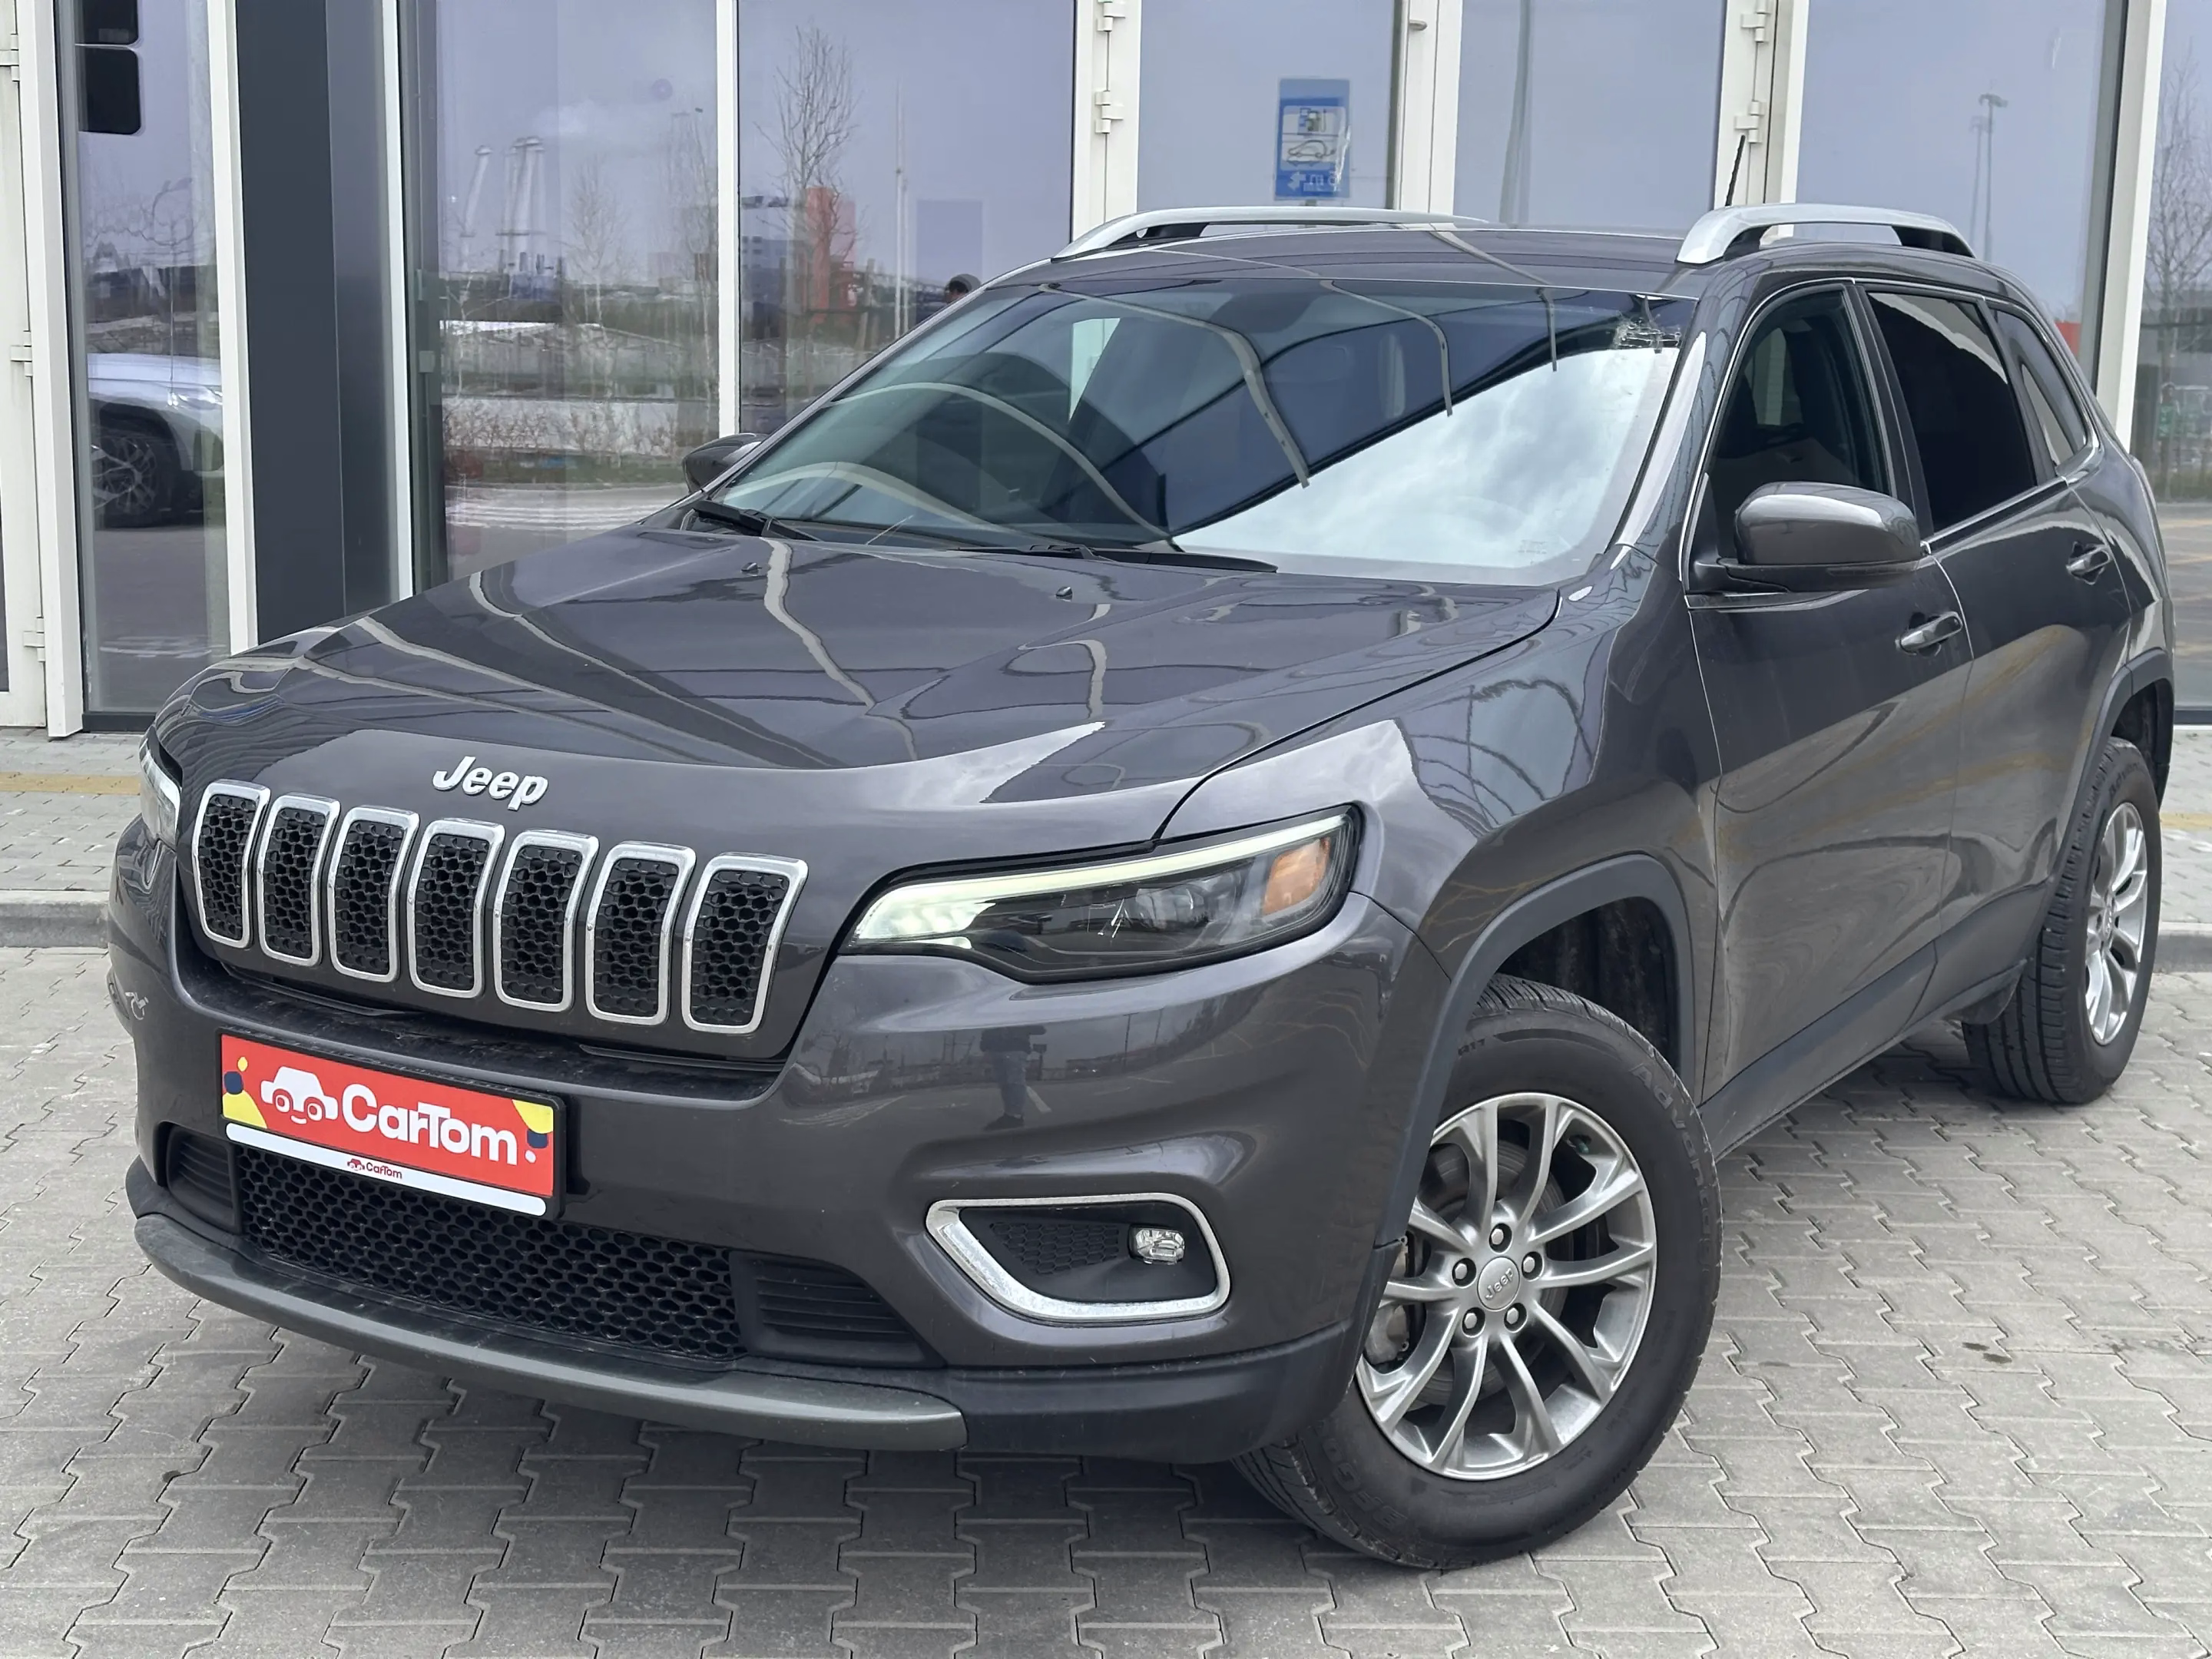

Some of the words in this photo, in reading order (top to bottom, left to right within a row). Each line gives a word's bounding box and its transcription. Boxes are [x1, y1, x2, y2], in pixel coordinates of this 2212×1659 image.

[432, 756, 548, 811] Jeep
[342, 1083, 518, 1166] CarTom
[366, 1161, 402, 1179] CarTom
[1485, 1267, 1514, 1300] Jeep
